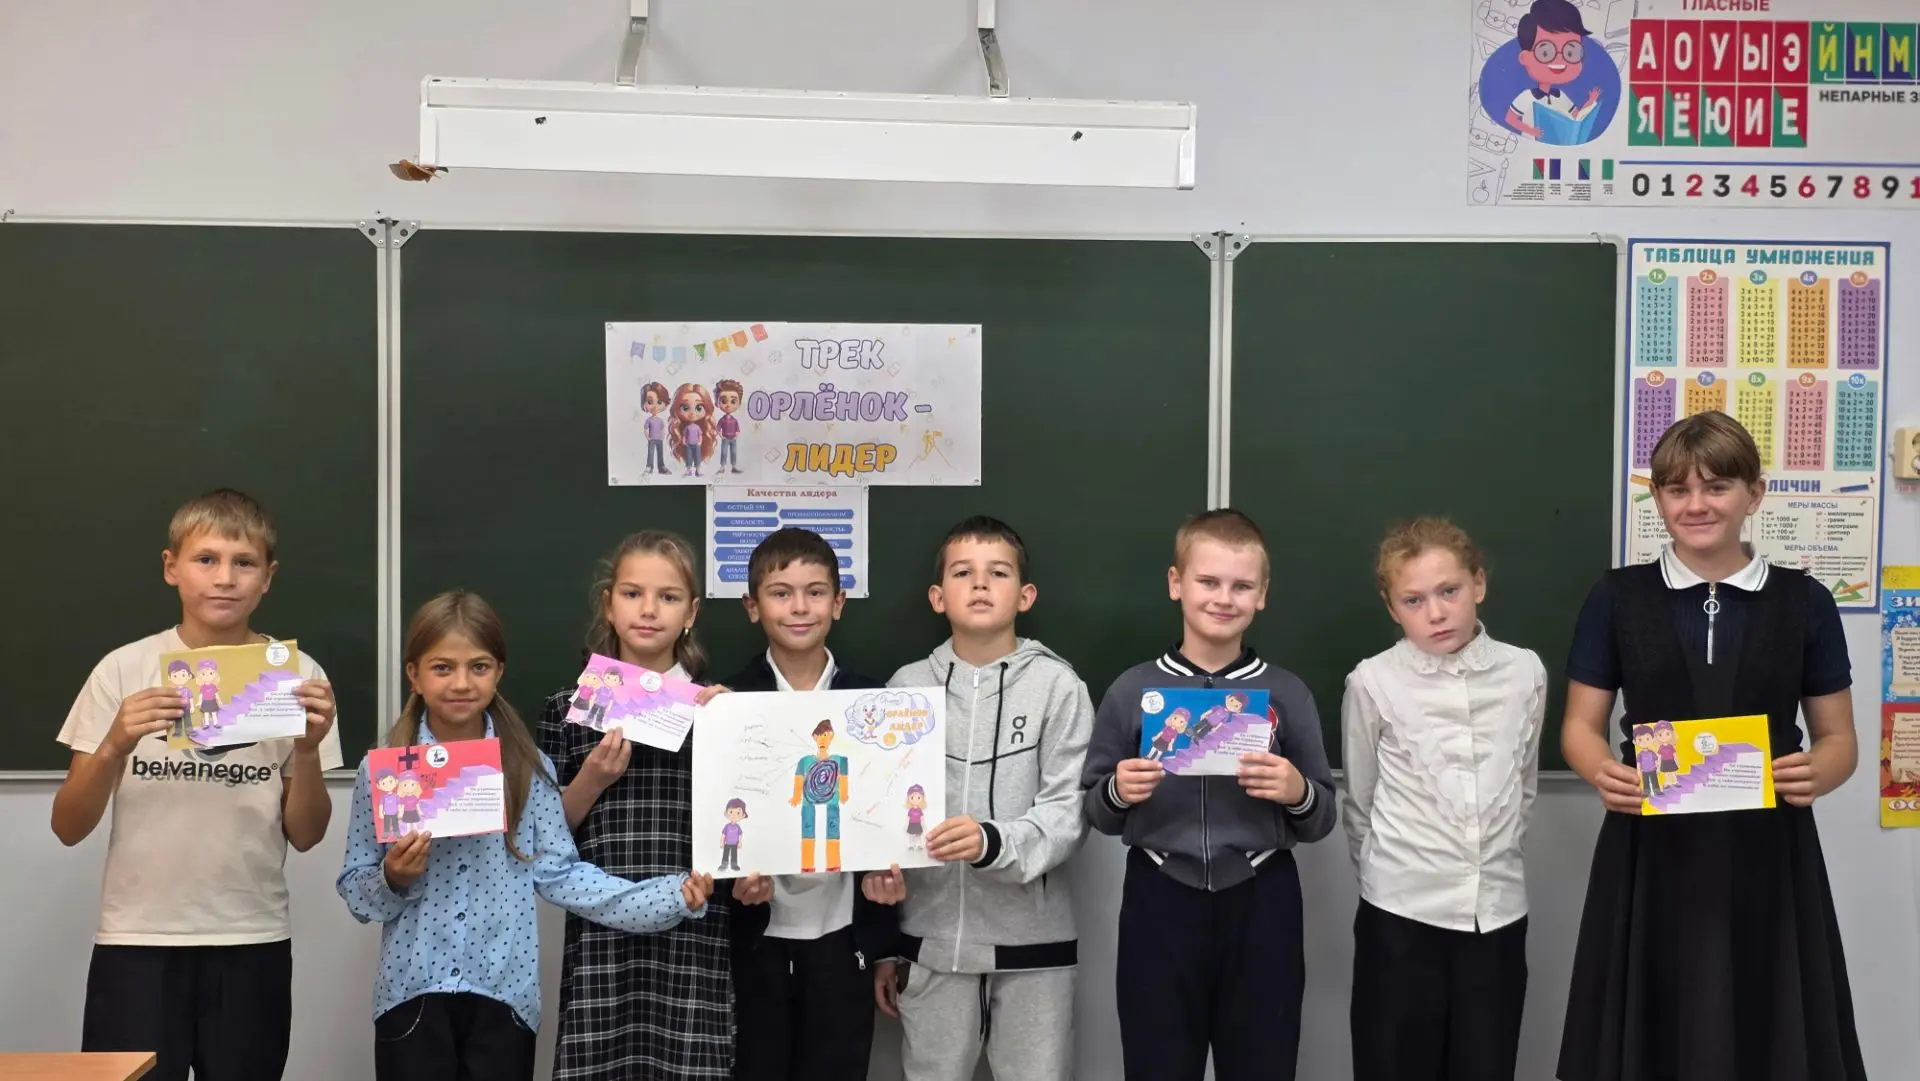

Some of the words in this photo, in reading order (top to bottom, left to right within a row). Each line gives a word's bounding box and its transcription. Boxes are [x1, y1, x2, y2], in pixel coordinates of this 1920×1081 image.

[1683, 0, 1770, 11] ГЛАСНЫЕ
[1637, 32, 1657, 70] А
[1674, 31, 1693, 71] О
[1709, 33, 1730, 71] У
[1743, 33, 1768, 71] Ы
[1782, 32, 1800, 72] Э
[1819, 24, 1837, 72] Й
[1854, 35, 1873, 72] Н
[1889, 35, 1909, 72] М
[1819, 90, 1906, 103] НЕПАРНЫЕ
[1637, 96, 1656, 133] Я
[1673, 92, 1691, 138] Ё
[1705, 96, 1731, 136] Ю
[1745, 98, 1764, 136] И
[1782, 98, 1799, 135] Е
[1632, 173, 1650, 197] 0
[1661, 173, 1675, 197] 1
[1686, 173, 1703, 197] 2
[1713, 174, 1730, 198] 3
[1741, 175, 1760, 198] 4
[1769, 175, 1787, 199] 5
[1798, 175, 1816, 199] 6
[1827, 175, 1844, 199] 7
[1853, 175, 1871, 200] 8
[1881, 176, 1900, 199] 9
[1643, 247, 1736, 265] ТАБЛИЦА
[1746, 249, 1875, 266] УМНОЖЕНИЯ
[795, 339, 885, 370] ТРЕК
[748, 383, 909, 422] ОРЛЁНОК
[782, 443, 898, 479] ЛИДЕР
[747, 488, 797, 497] Качества
[800, 490, 838, 499] лидера
[1768, 479, 1821, 493] ЛИЧИН
[131, 755, 272, 784] beivanegce
